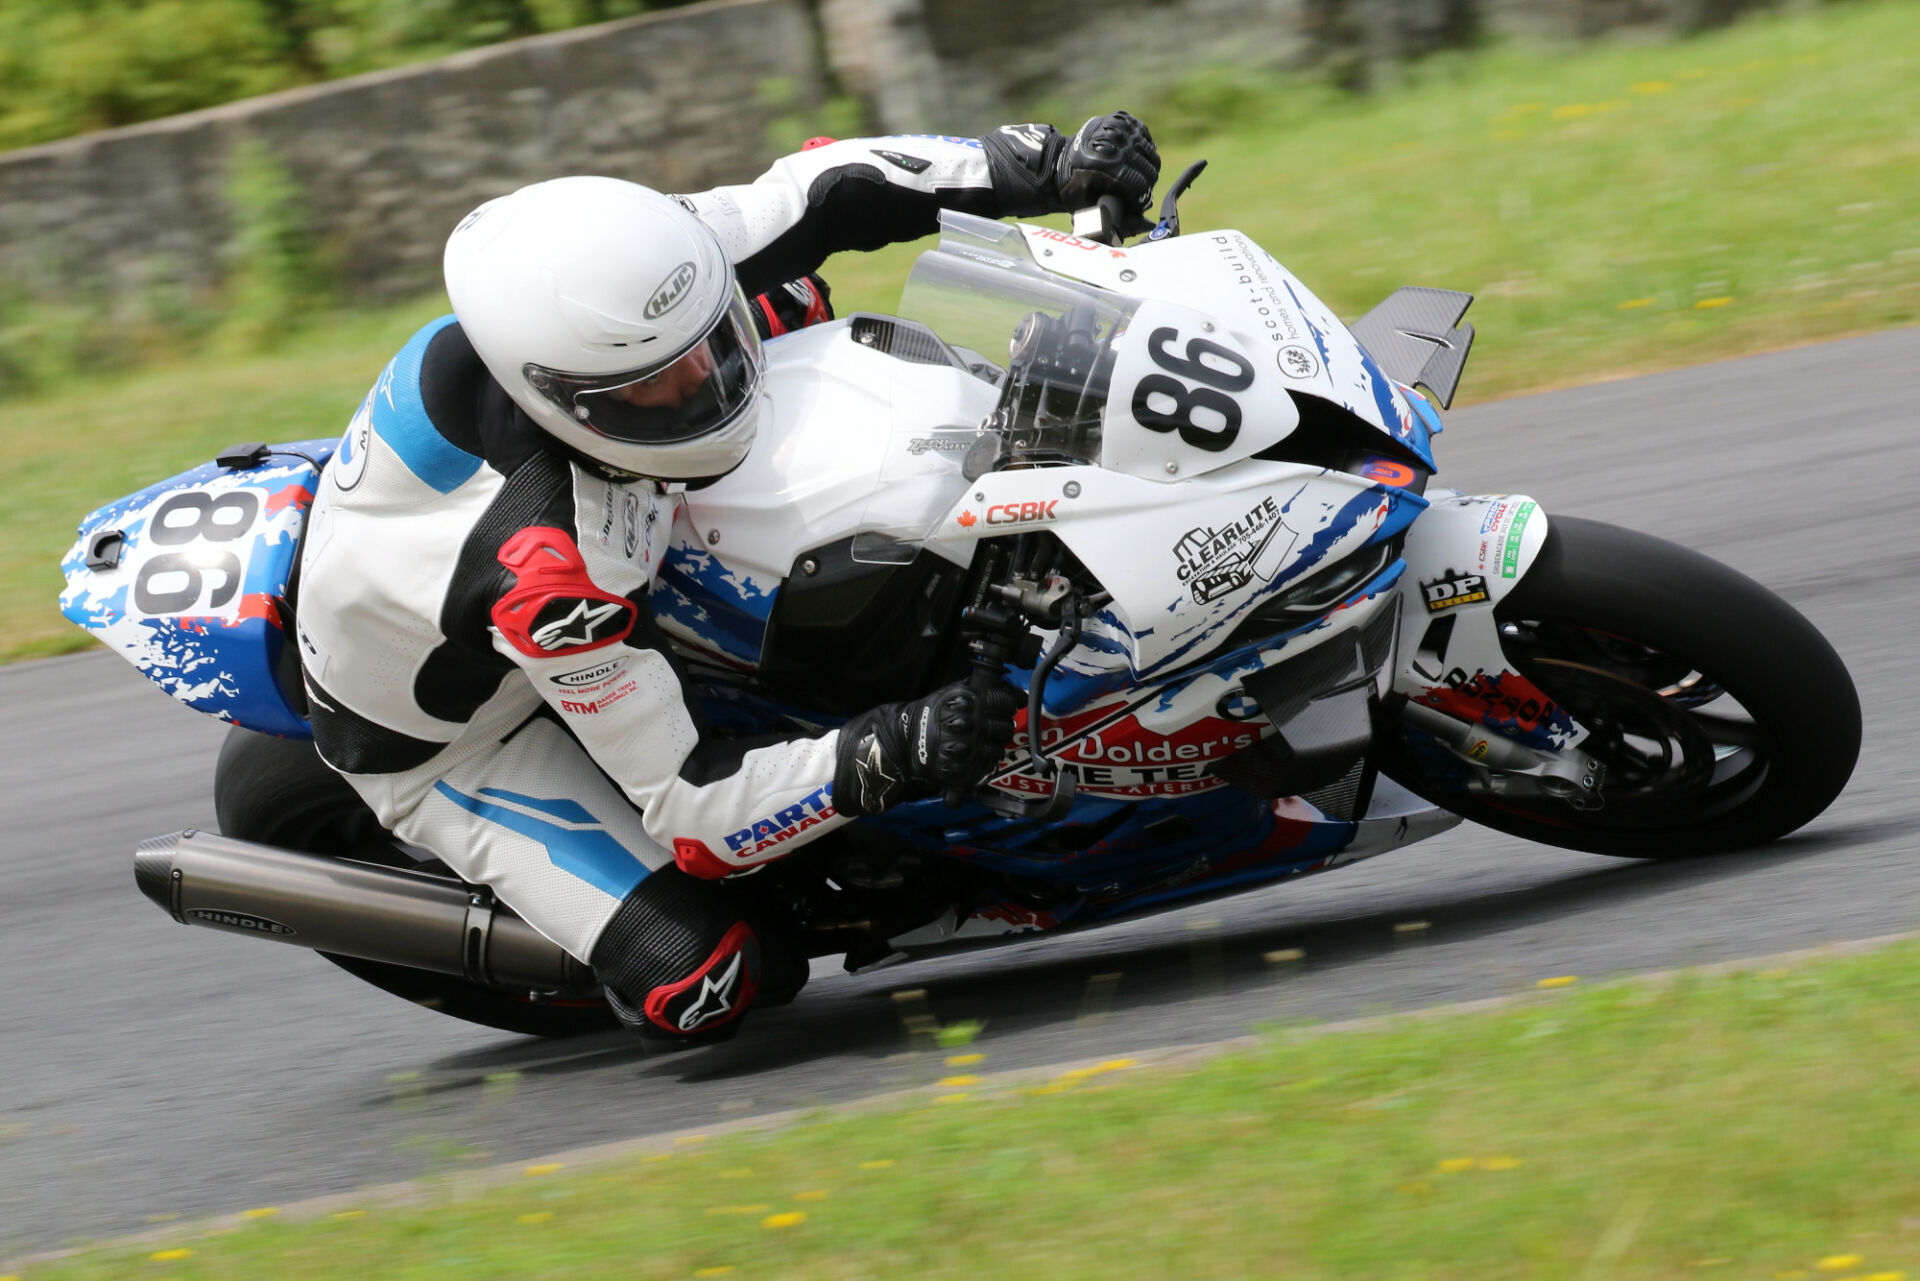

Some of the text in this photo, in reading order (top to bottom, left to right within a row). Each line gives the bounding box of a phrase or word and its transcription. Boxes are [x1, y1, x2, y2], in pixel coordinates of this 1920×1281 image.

[650, 264, 694, 318] HJC
[1211, 234, 1284, 342] scot-build
[1232, 233, 1301, 341] homes and renovations
[1131, 326, 1256, 452] 86
[986, 499, 1059, 525] CSBK
[1237, 508, 1280, 544] 705-446-1407
[1490, 502, 1508, 532] CYCLE
[134, 491, 259, 615] 86
[1177, 495, 1278, 580] CLEARLITE
[1427, 575, 1483, 602] DP
[569, 661, 618, 683] HINDLE
[576, 684, 600, 694] MORE
[559, 699, 598, 713] BTM
[1012, 719, 1253, 763] on Dolder's
[736, 805, 839, 858] CANAD
[197, 911, 284, 934] HINDLE
